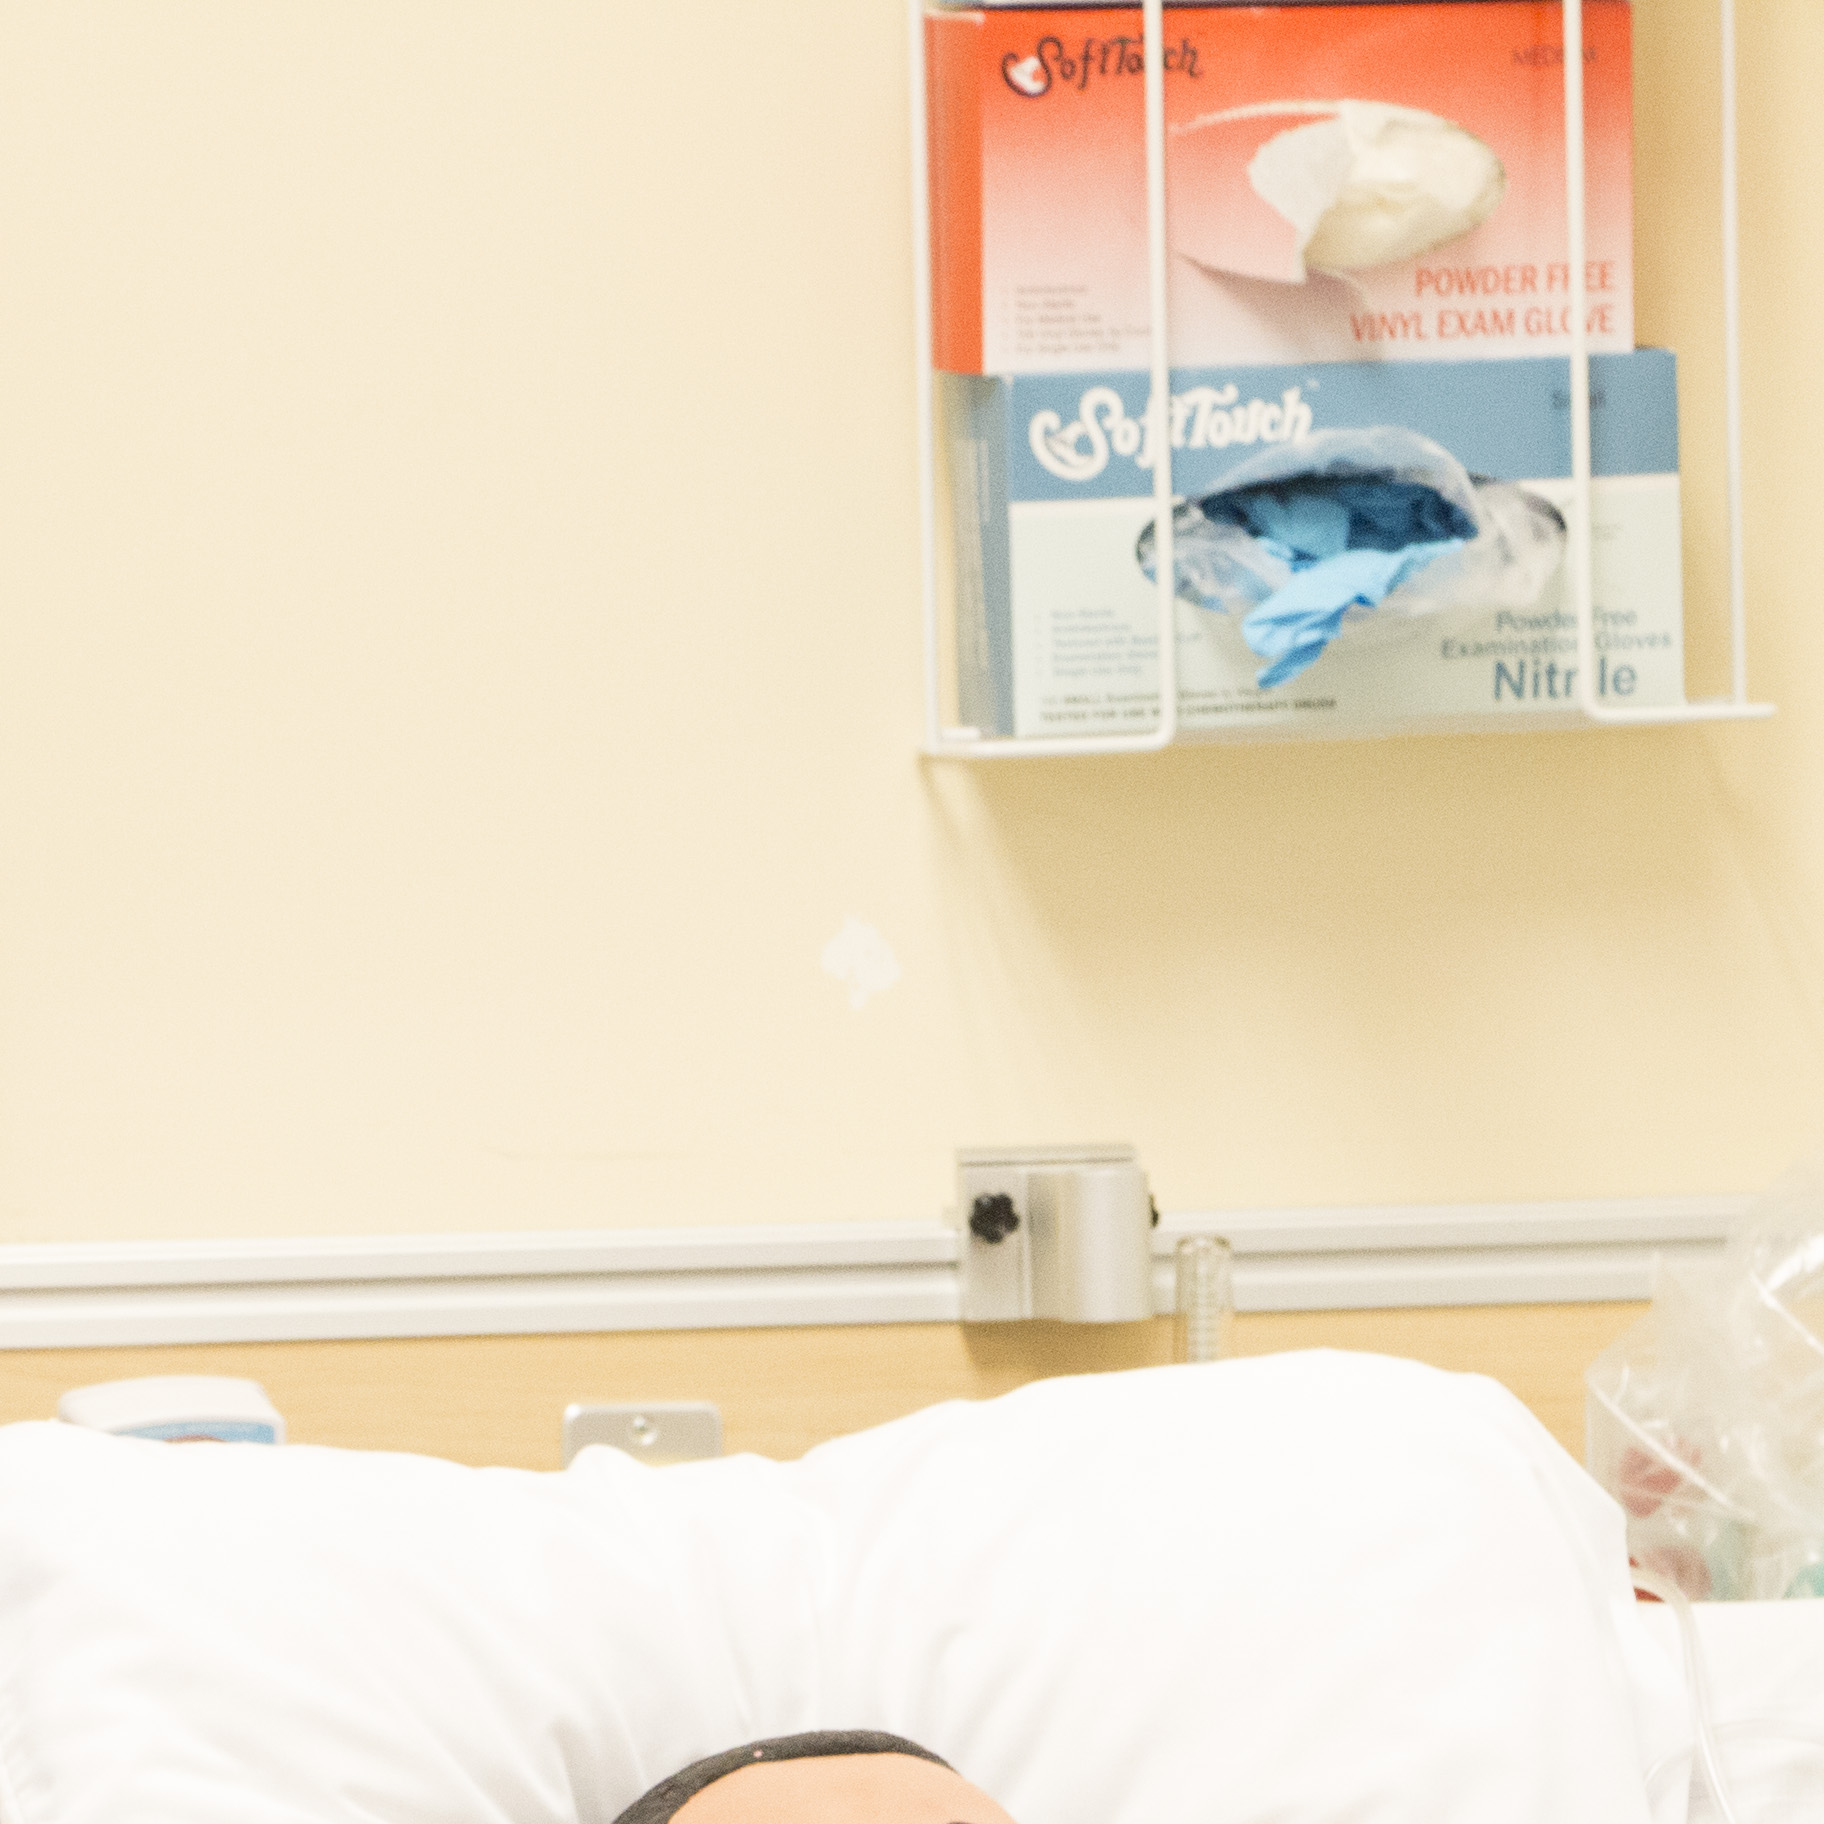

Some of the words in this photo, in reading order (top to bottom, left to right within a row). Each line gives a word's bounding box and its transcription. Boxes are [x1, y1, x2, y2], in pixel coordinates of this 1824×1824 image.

[1002, 35, 1203, 98] SoftToch
[1415, 264, 1538, 297] POWDER
[1350, 311, 1428, 342] VINYL
[1437, 308, 1516, 339] EXAM
[1494, 655, 1638, 701] Nitrle
